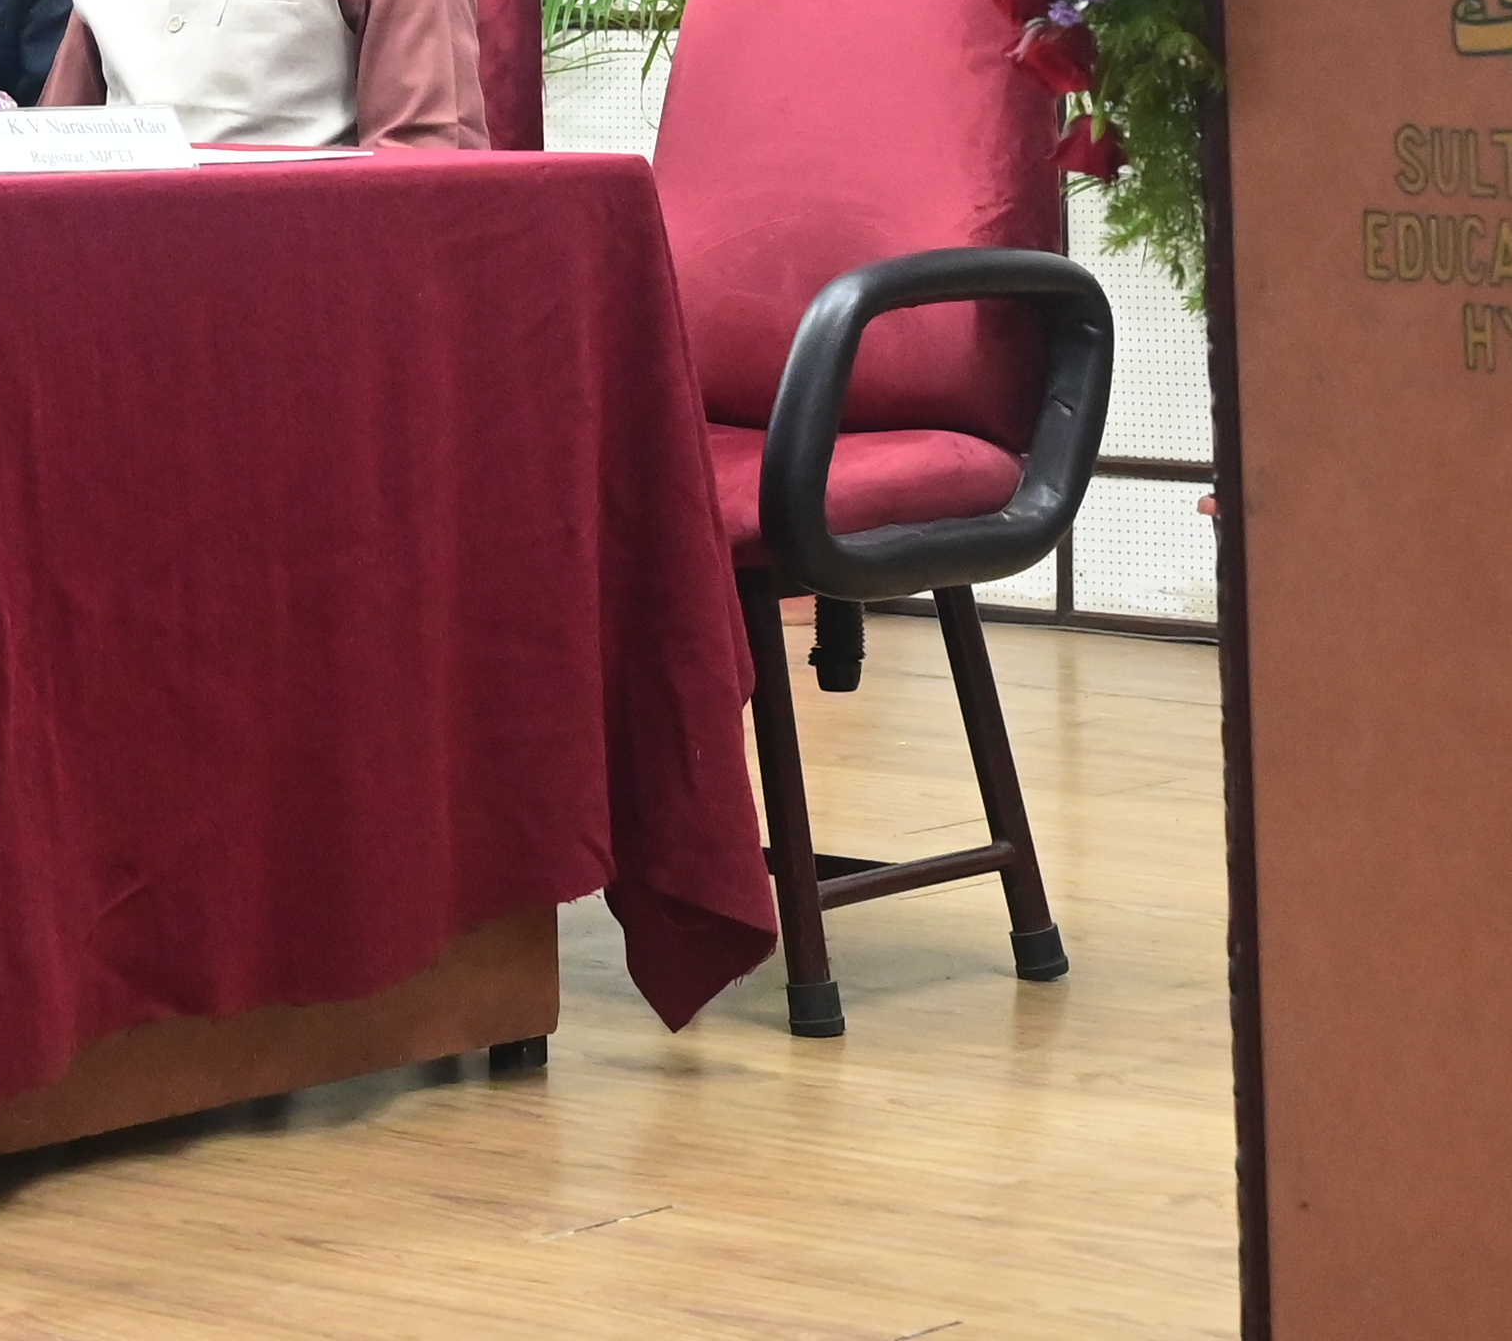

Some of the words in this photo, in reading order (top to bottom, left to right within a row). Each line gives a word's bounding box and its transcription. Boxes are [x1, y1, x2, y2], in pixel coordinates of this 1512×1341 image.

[7, 118, 25, 136] K
[26, 117, 40, 134] V
[45, 117, 132, 136] Narasimha
[133, 117, 167, 135] Rao
[29, 149, 89, 167] Registrar,
[89, 149, 136, 164] MJCET
